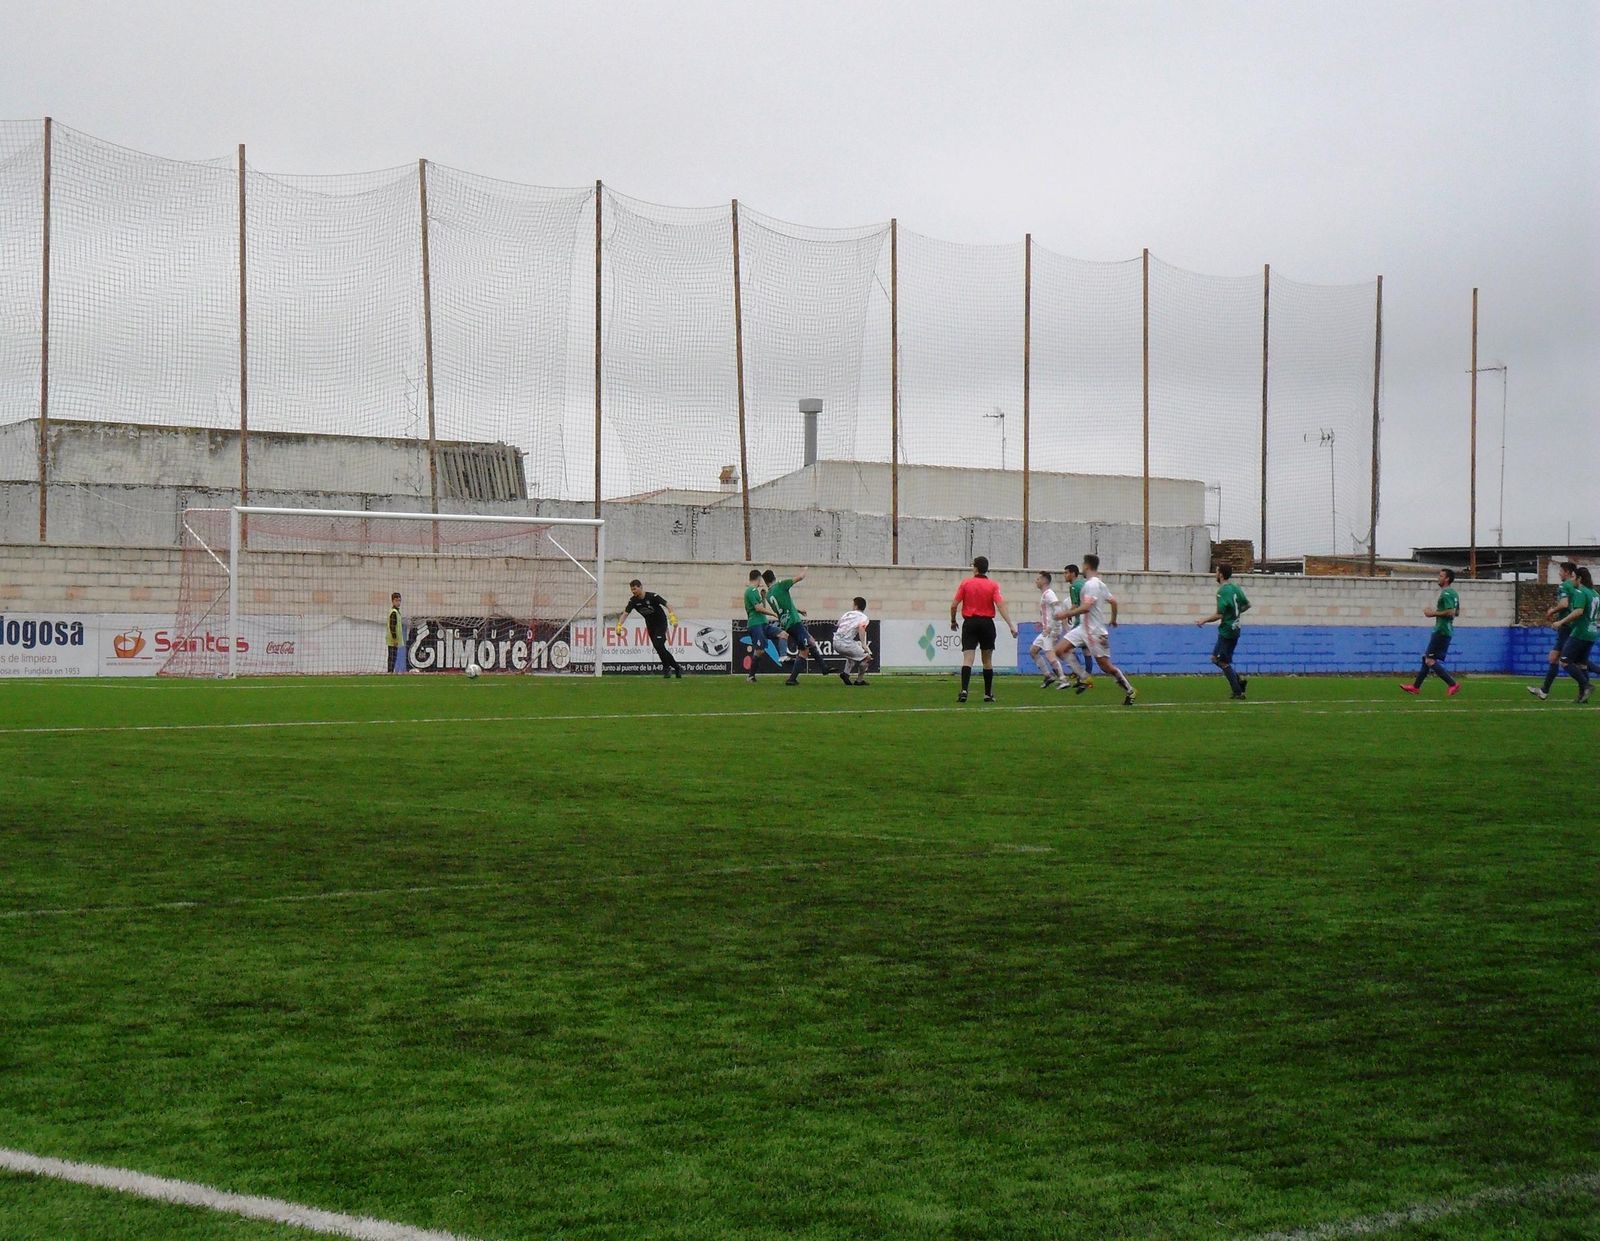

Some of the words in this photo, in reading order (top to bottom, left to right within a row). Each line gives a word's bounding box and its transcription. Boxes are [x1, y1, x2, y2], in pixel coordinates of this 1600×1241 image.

[154, 631, 250, 653] Santos
[635, 626, 693, 647] MVIL
[8, 653, 20, 663] de
[21, 653, 57, 665] limpieza
[24, 667, 53, 675] Fundada
[65, 667, 80, 675] 1953
[621, 664, 640, 673] puente
